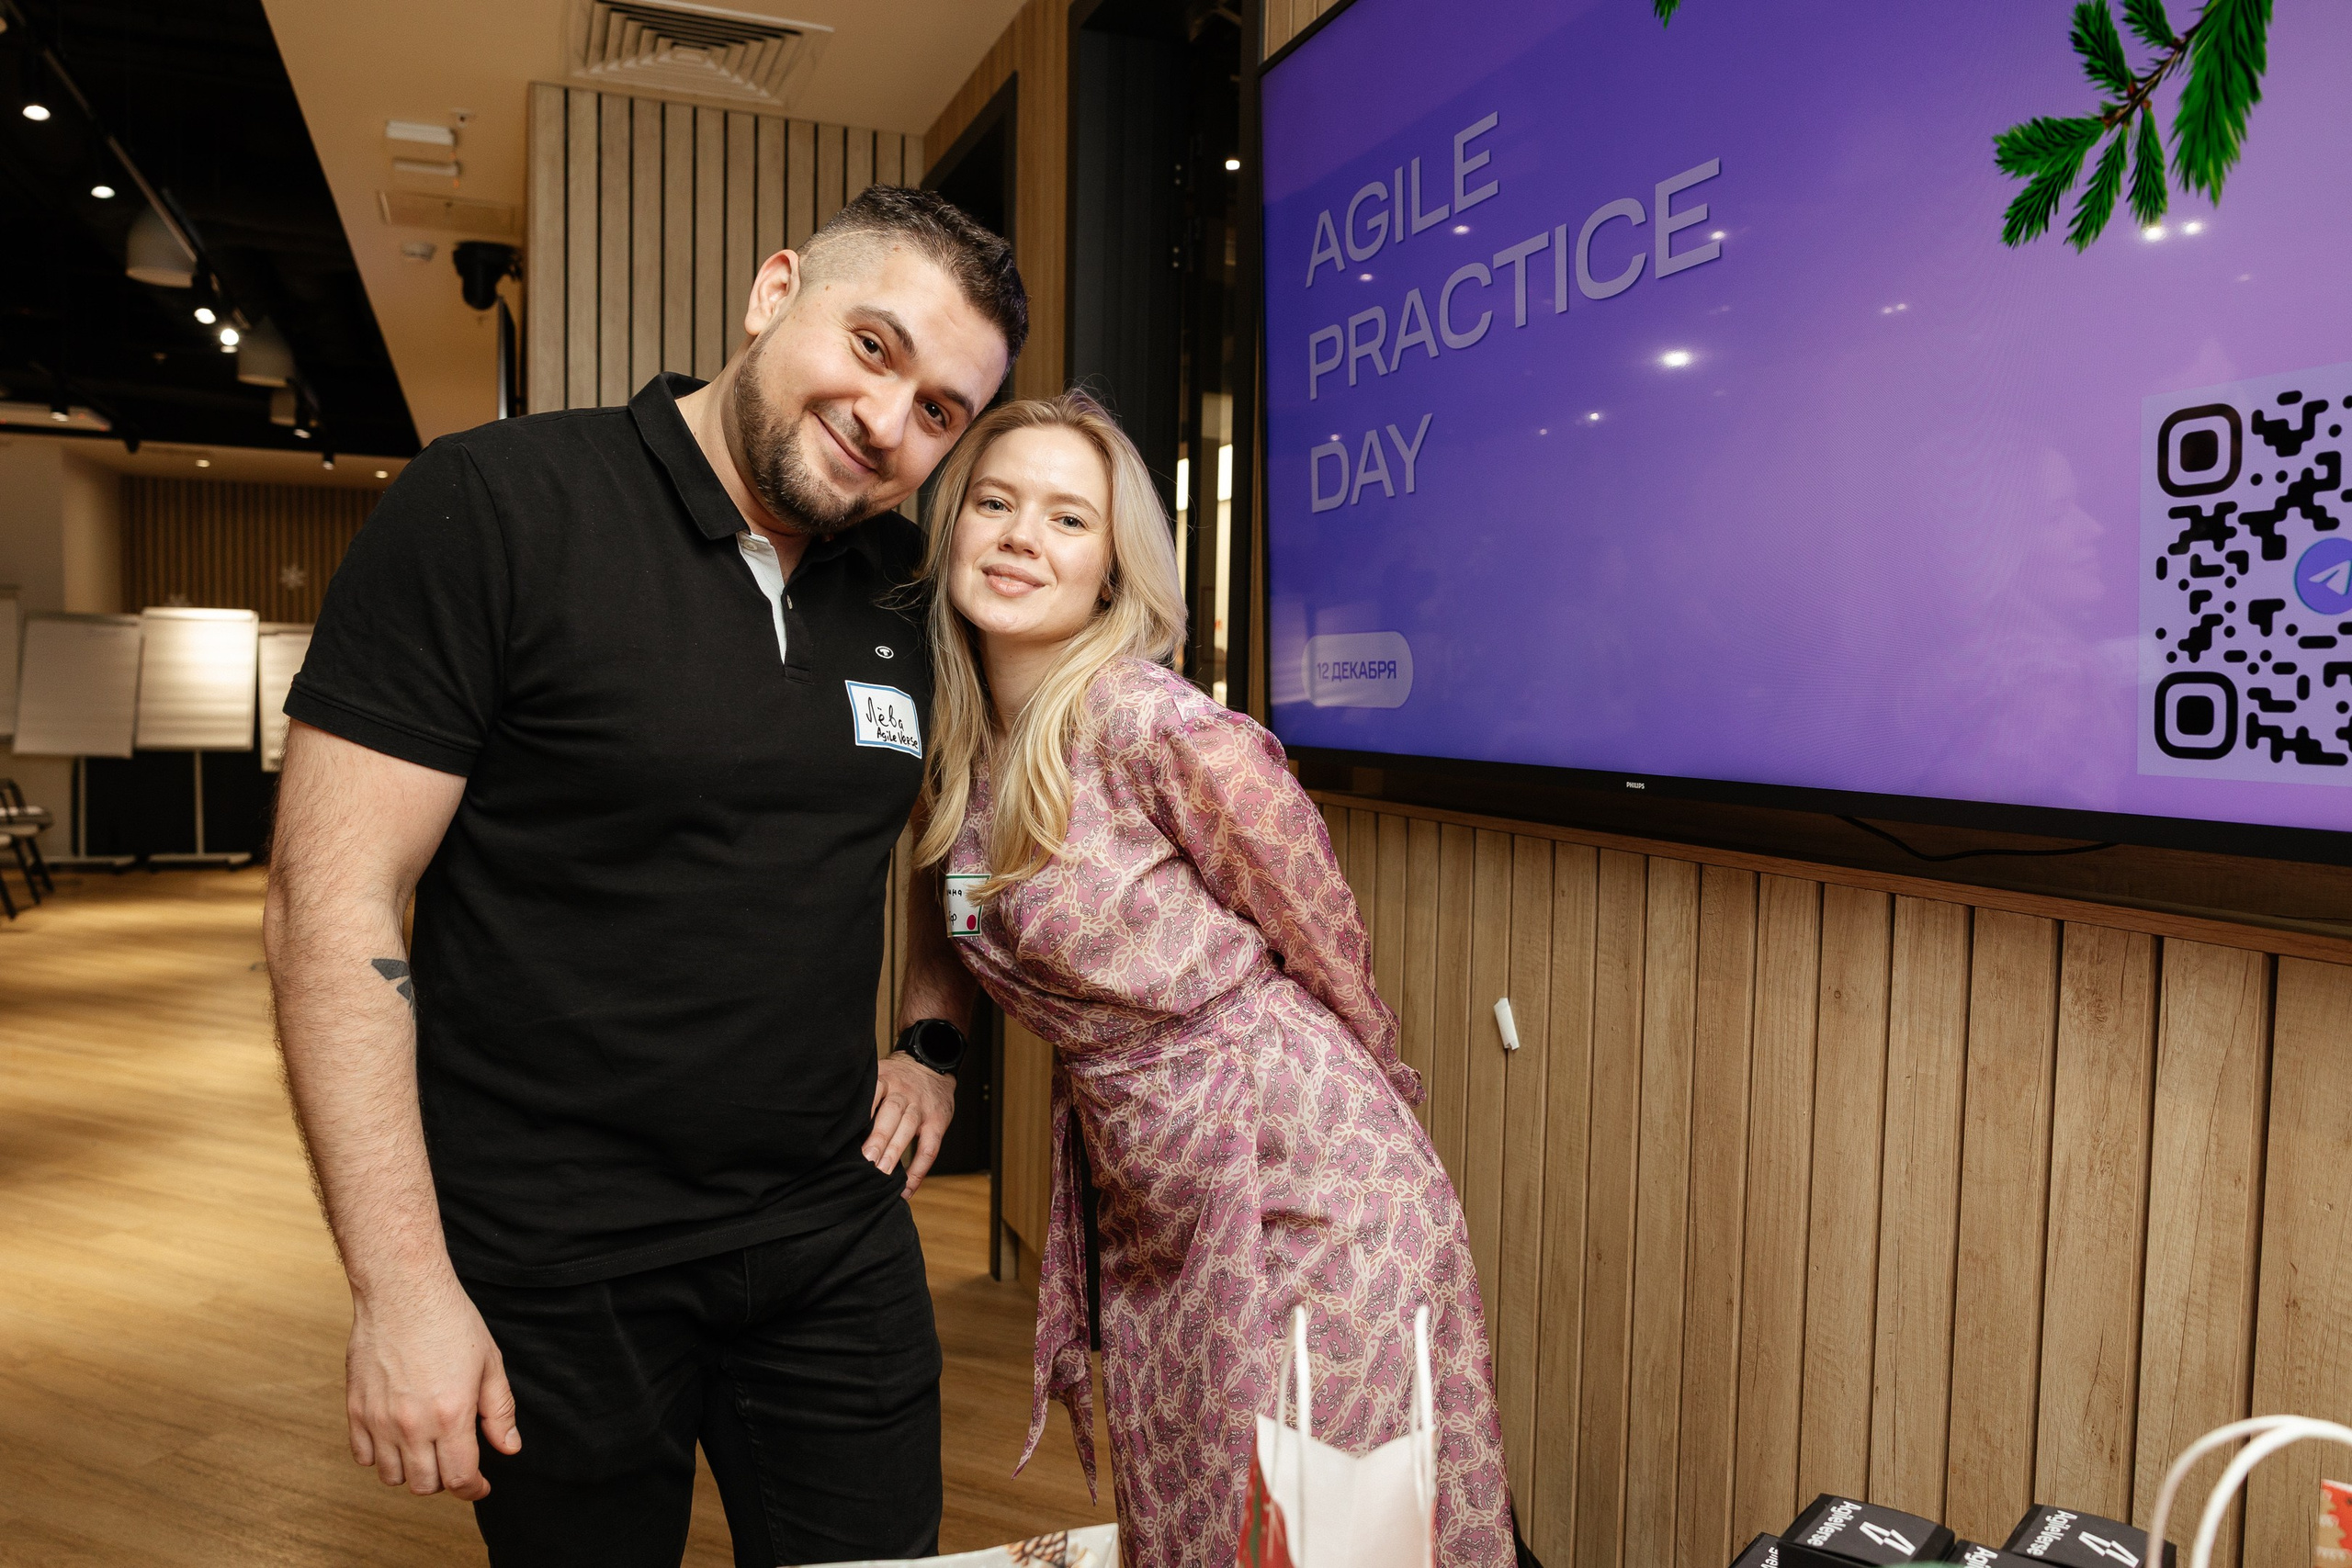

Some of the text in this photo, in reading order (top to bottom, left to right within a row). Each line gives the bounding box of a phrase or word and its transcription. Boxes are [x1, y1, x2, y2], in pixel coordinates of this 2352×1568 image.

[1306, 110, 1498, 288] AGILE
[1309, 157, 1721, 400] PRACTICE
[1310, 413, 1432, 513] DAY
[1317, 660, 1396, 682] 12 ДЕКАБРЯ
[1626, 782, 1645, 790] PHILIPS
[1807, 1500, 1862, 1547] AgileVerse
[2026, 1509, 2078, 1556] AgileVerse
